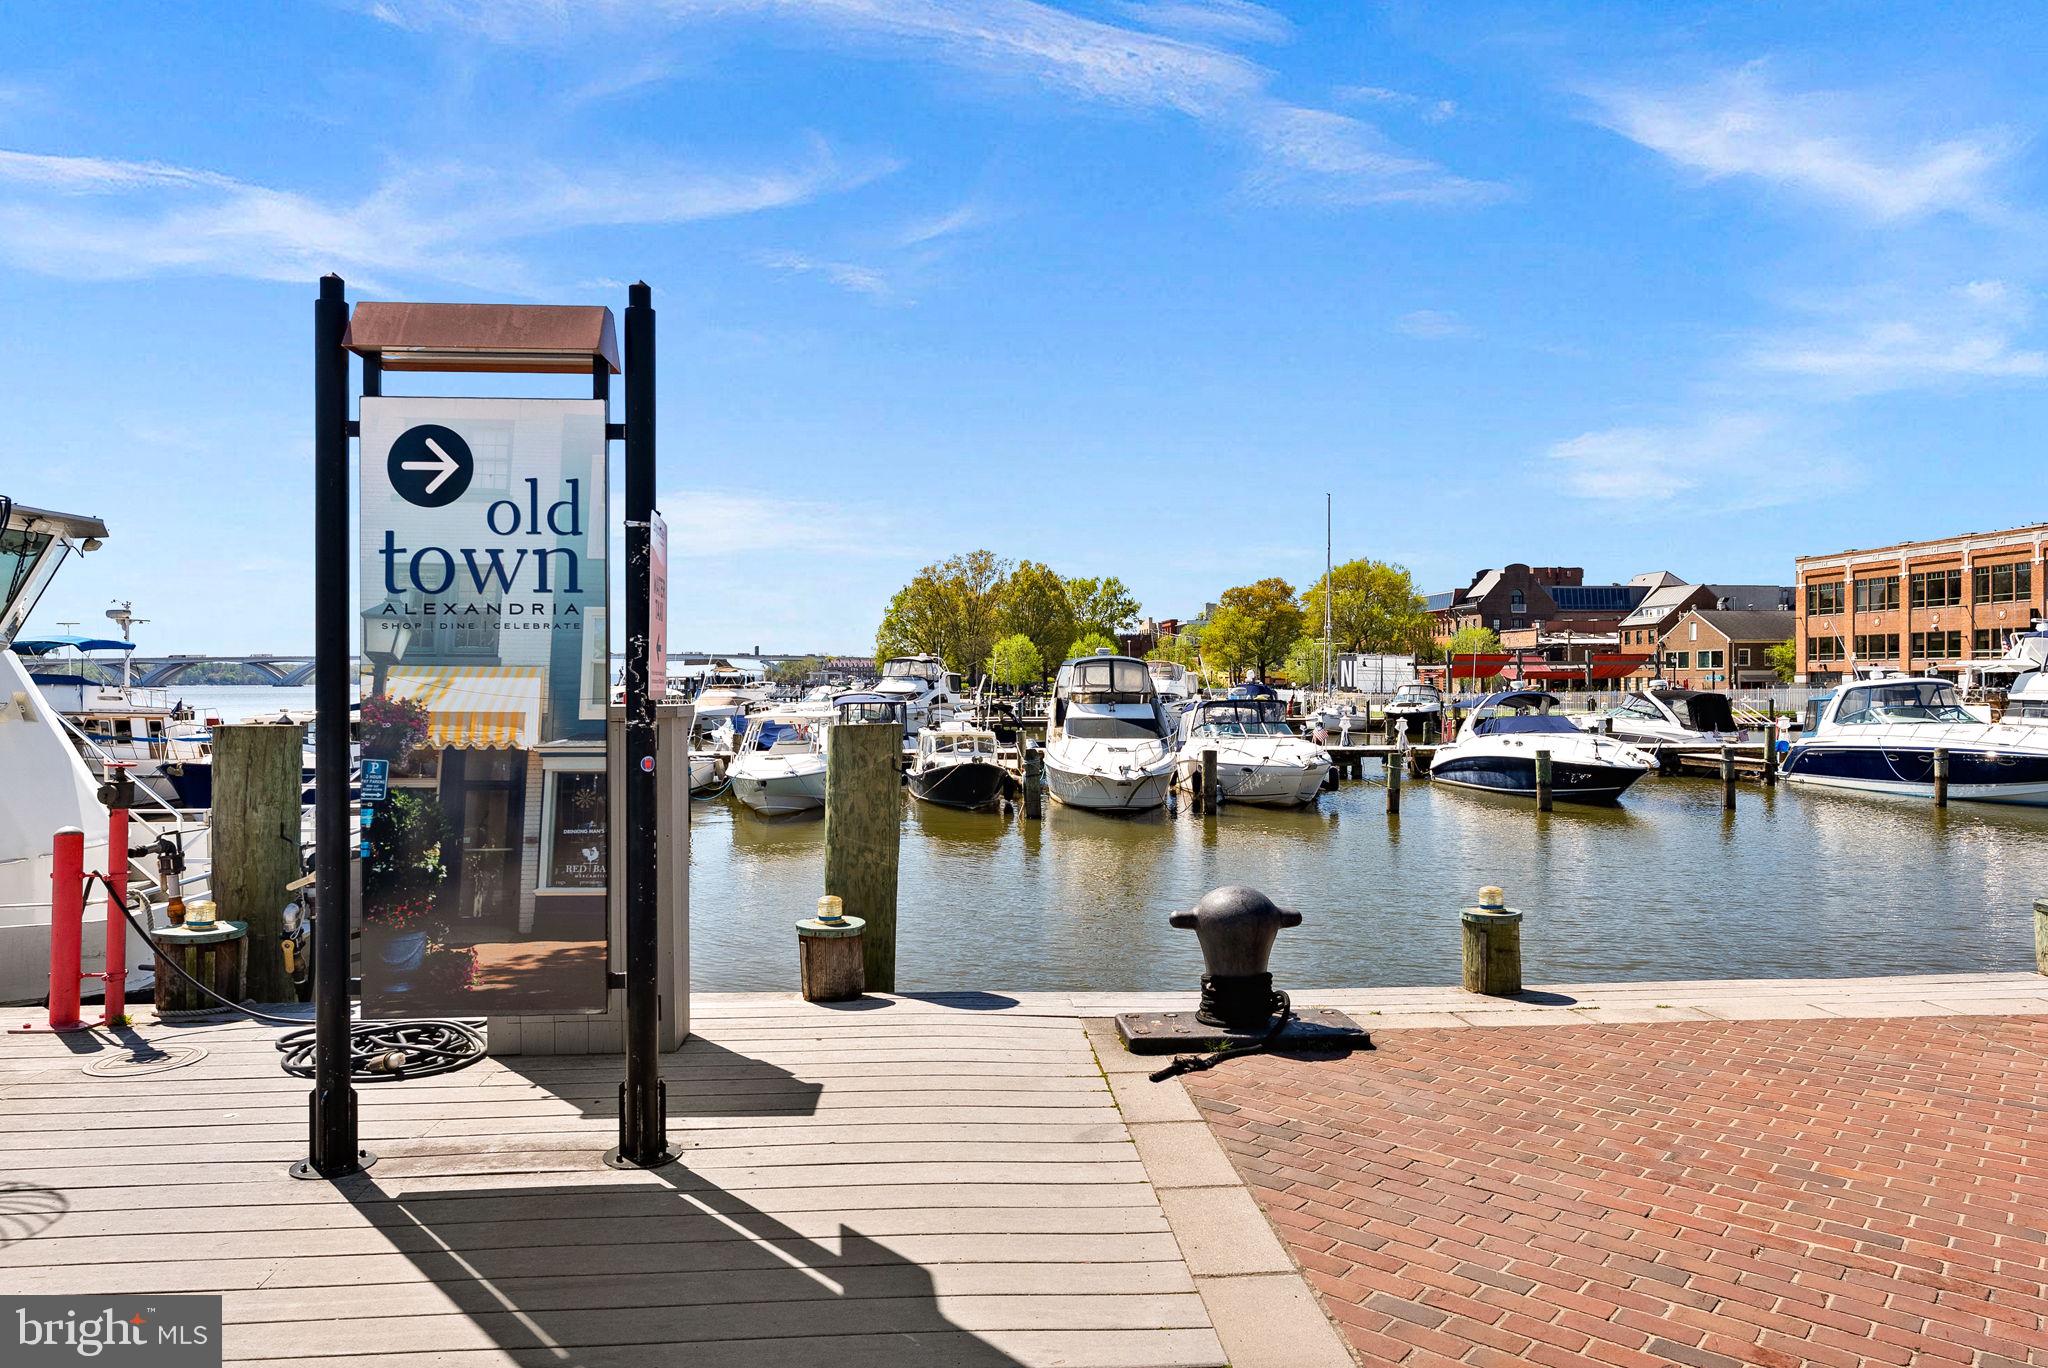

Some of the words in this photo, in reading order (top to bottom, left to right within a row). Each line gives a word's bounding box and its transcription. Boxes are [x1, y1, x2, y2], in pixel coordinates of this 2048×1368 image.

[486, 477, 583, 536] old
[378, 530, 584, 595] town
[381, 602, 580, 615] ALEXANDRIA
[381, 622, 422, 630] SHOP
[439, 622, 475, 630] DINE
[493, 622, 581, 630] CELEBRATE
[370, 762, 380, 774] P
[566, 865, 587, 873] RED
